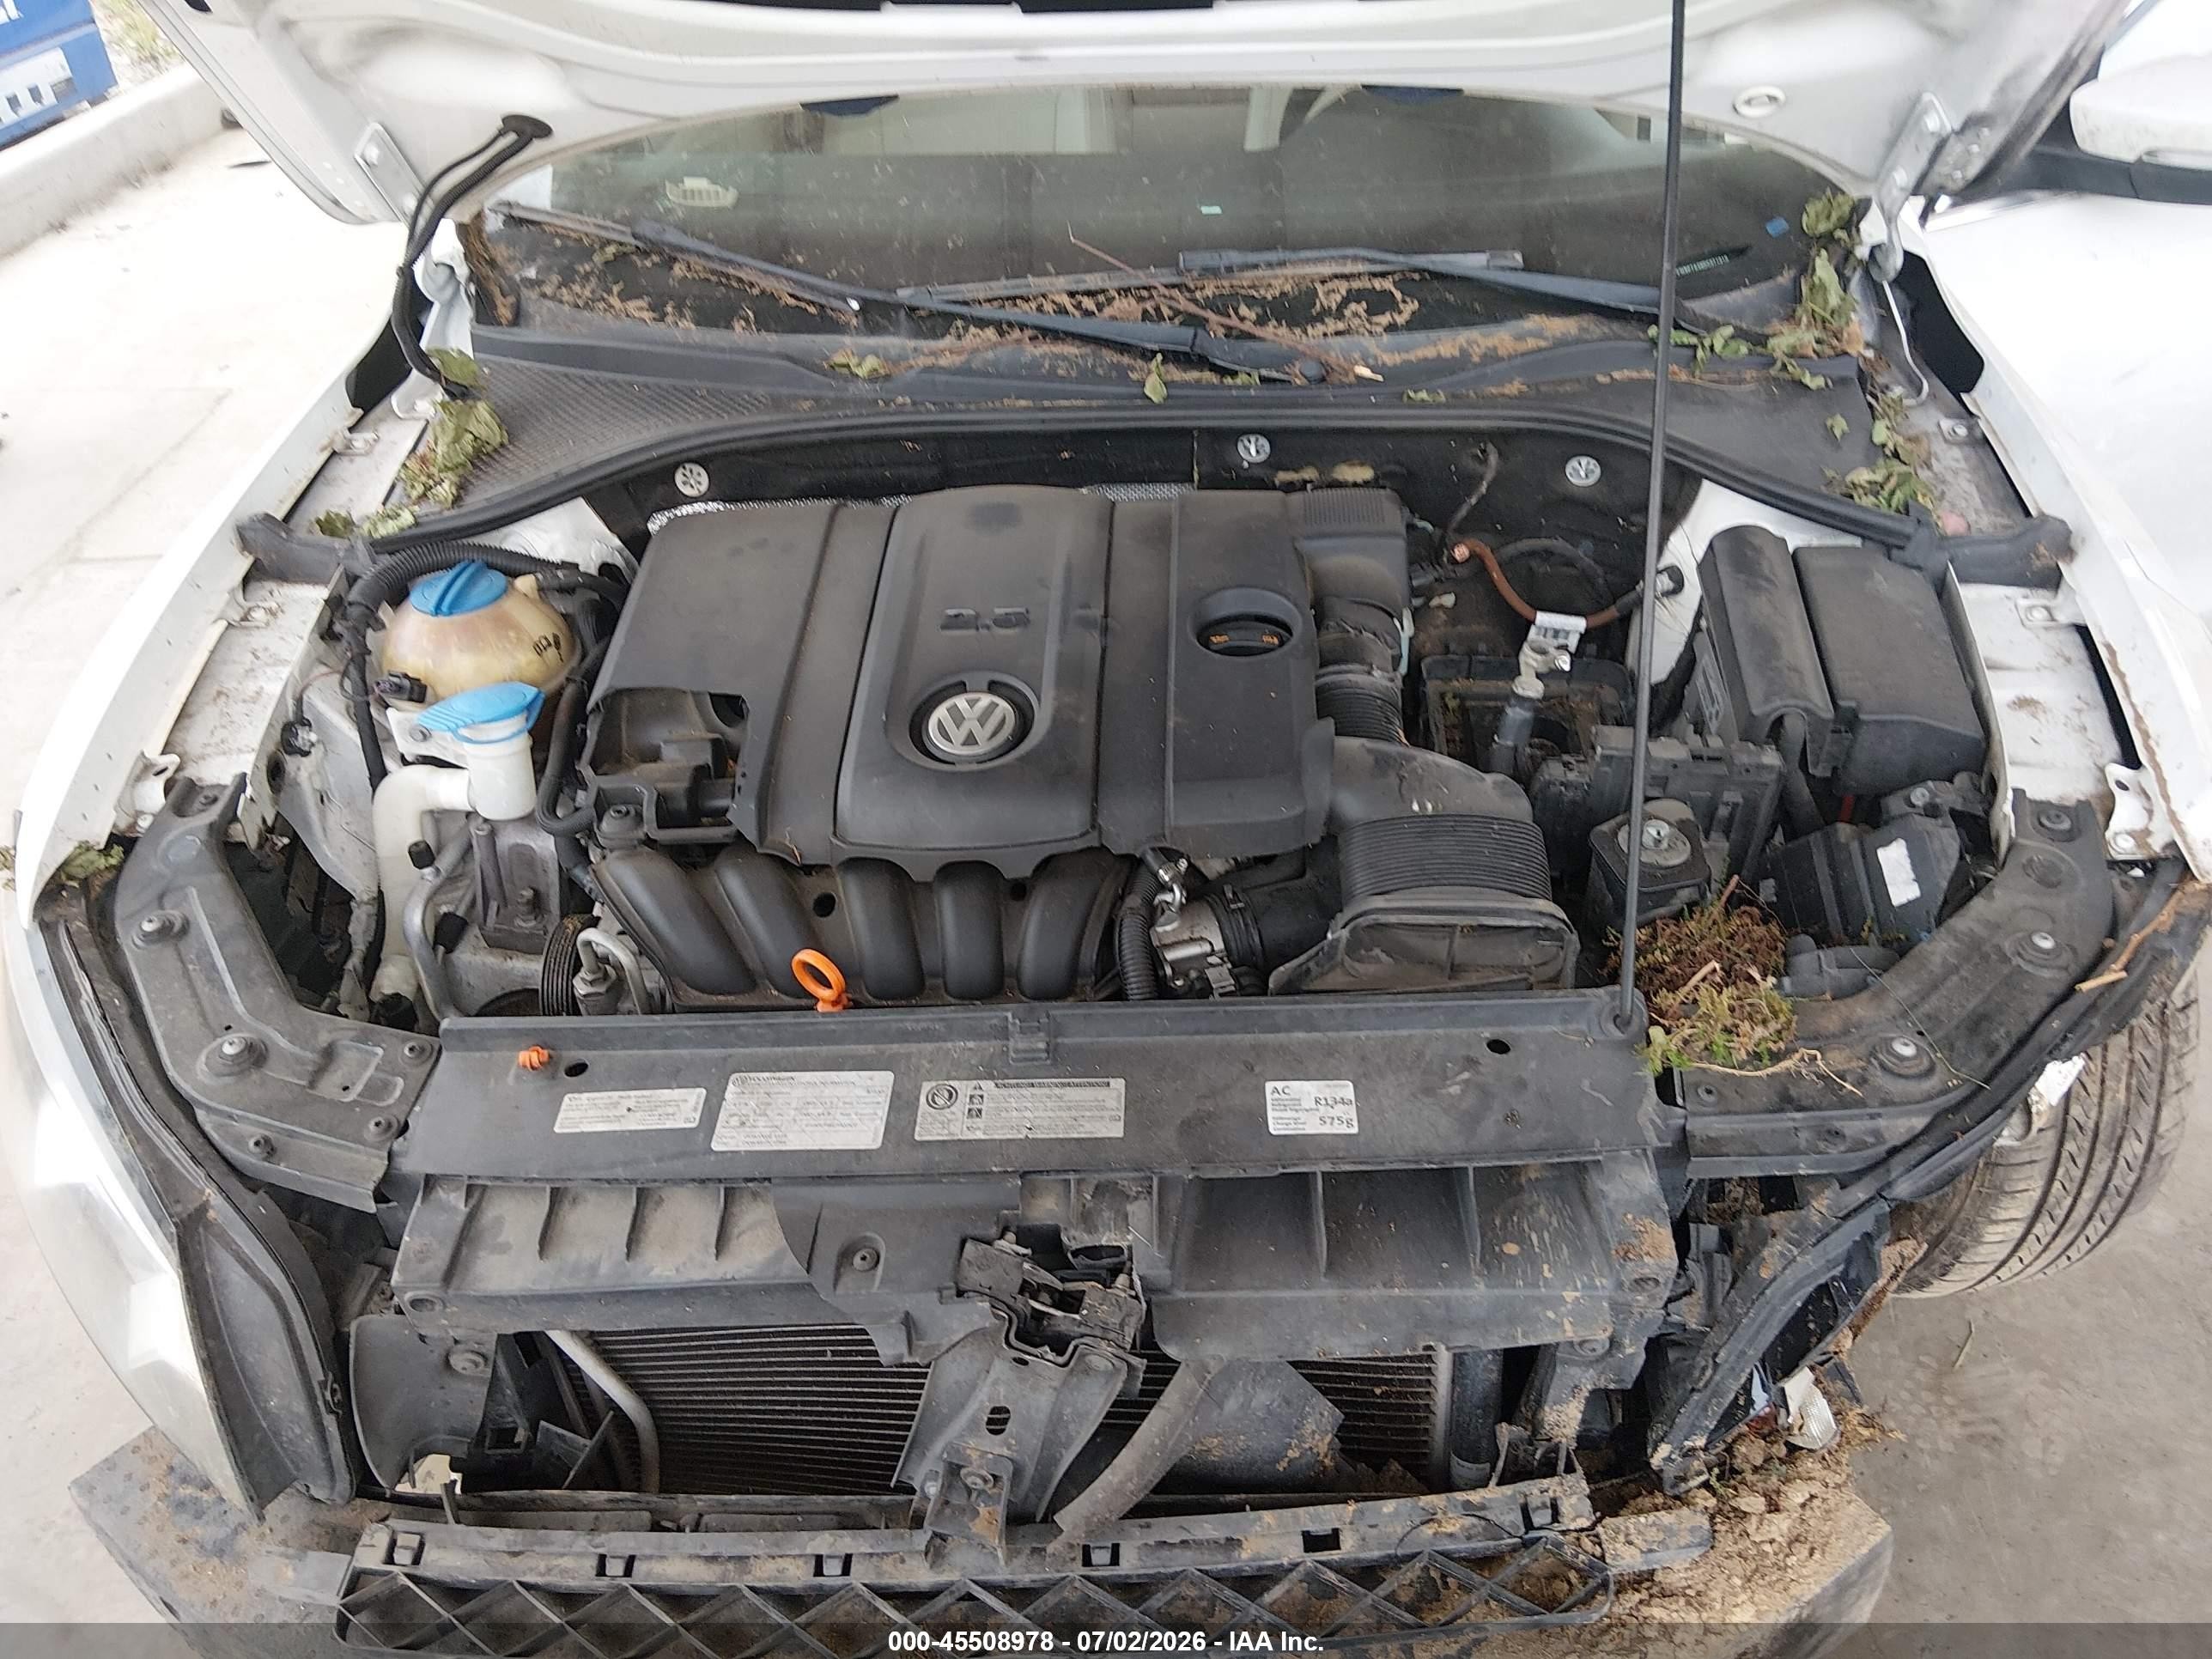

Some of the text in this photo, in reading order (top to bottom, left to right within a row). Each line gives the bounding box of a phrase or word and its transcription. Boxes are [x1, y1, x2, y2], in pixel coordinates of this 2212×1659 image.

[1271, 1085, 1291, 1096] AC
[1314, 1097, 1353, 1108] R134a
[1319, 1115, 1354, 1128] 575g
